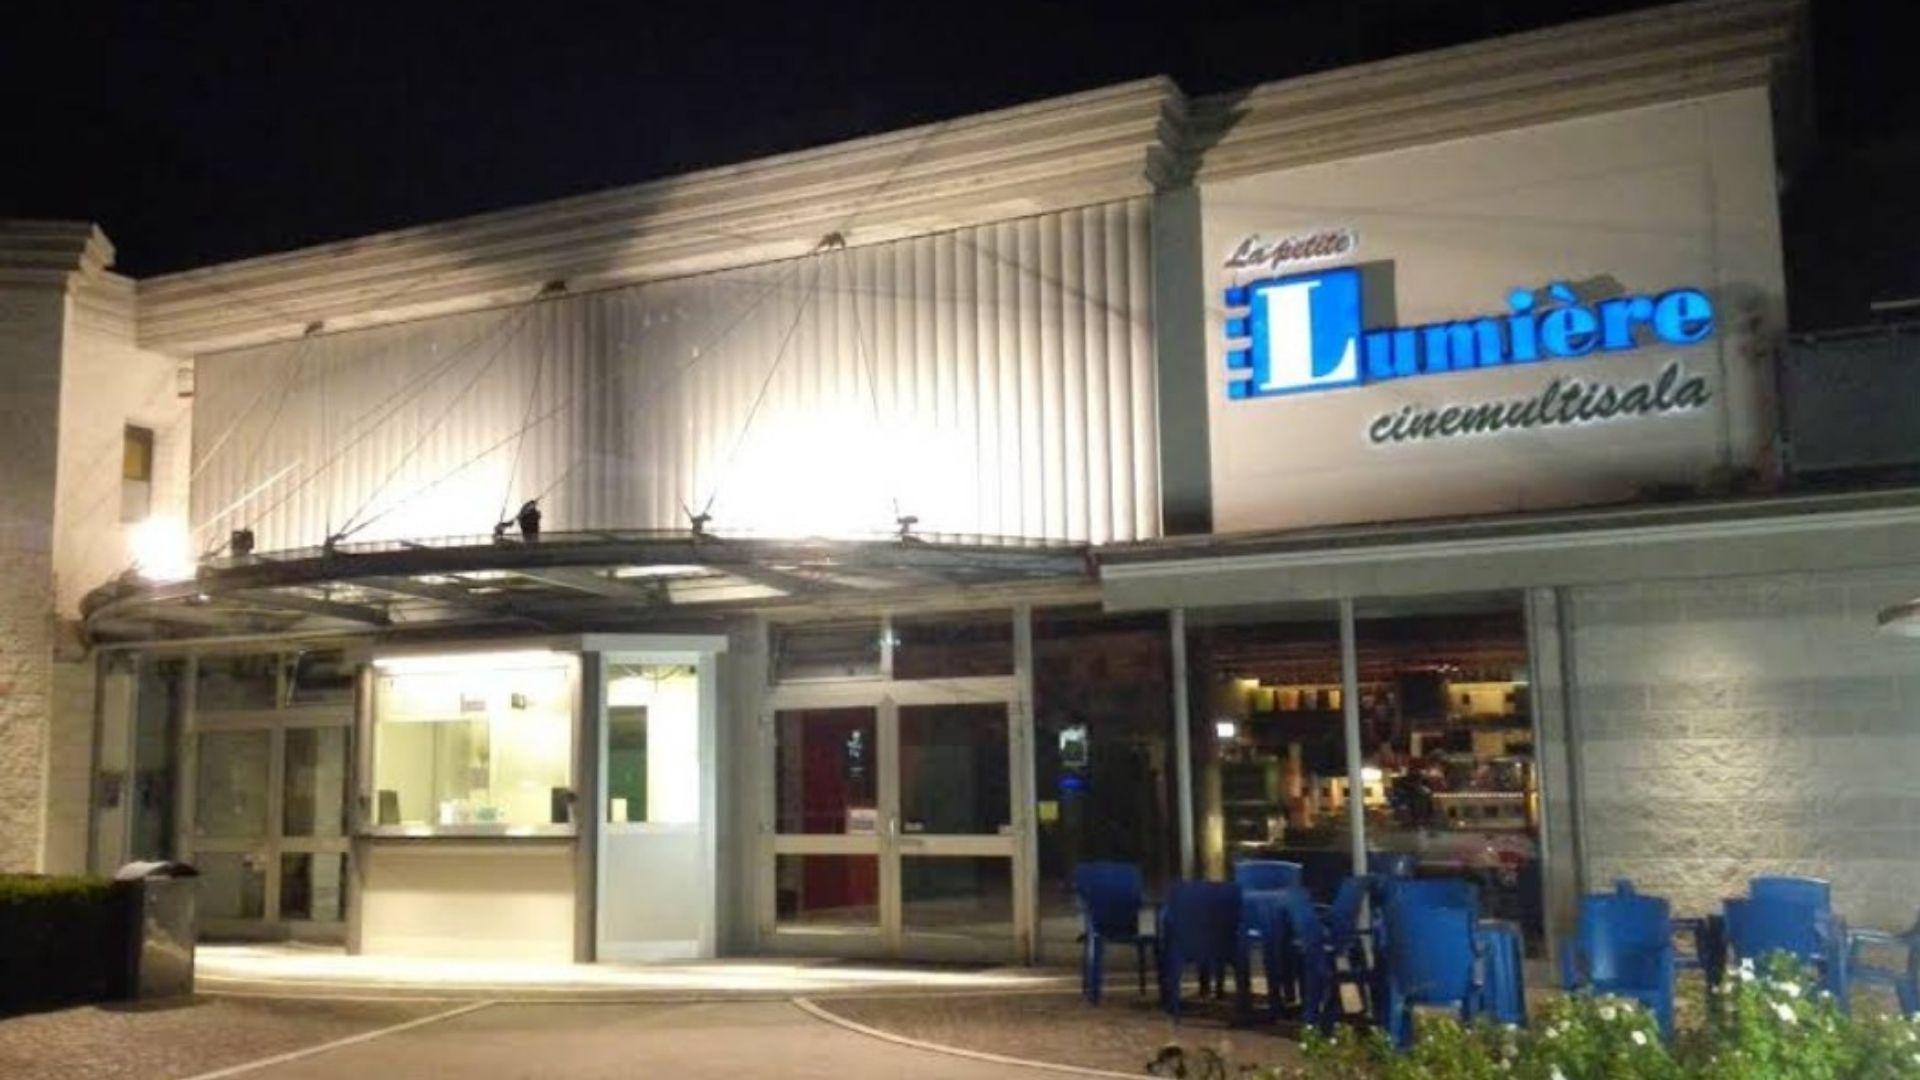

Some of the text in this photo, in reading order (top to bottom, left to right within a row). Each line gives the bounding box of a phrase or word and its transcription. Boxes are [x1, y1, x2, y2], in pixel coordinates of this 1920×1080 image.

[1223, 232, 1350, 270] La petite
[1255, 279, 1714, 392] Lumière
[1369, 362, 1712, 443] cinemultisala
